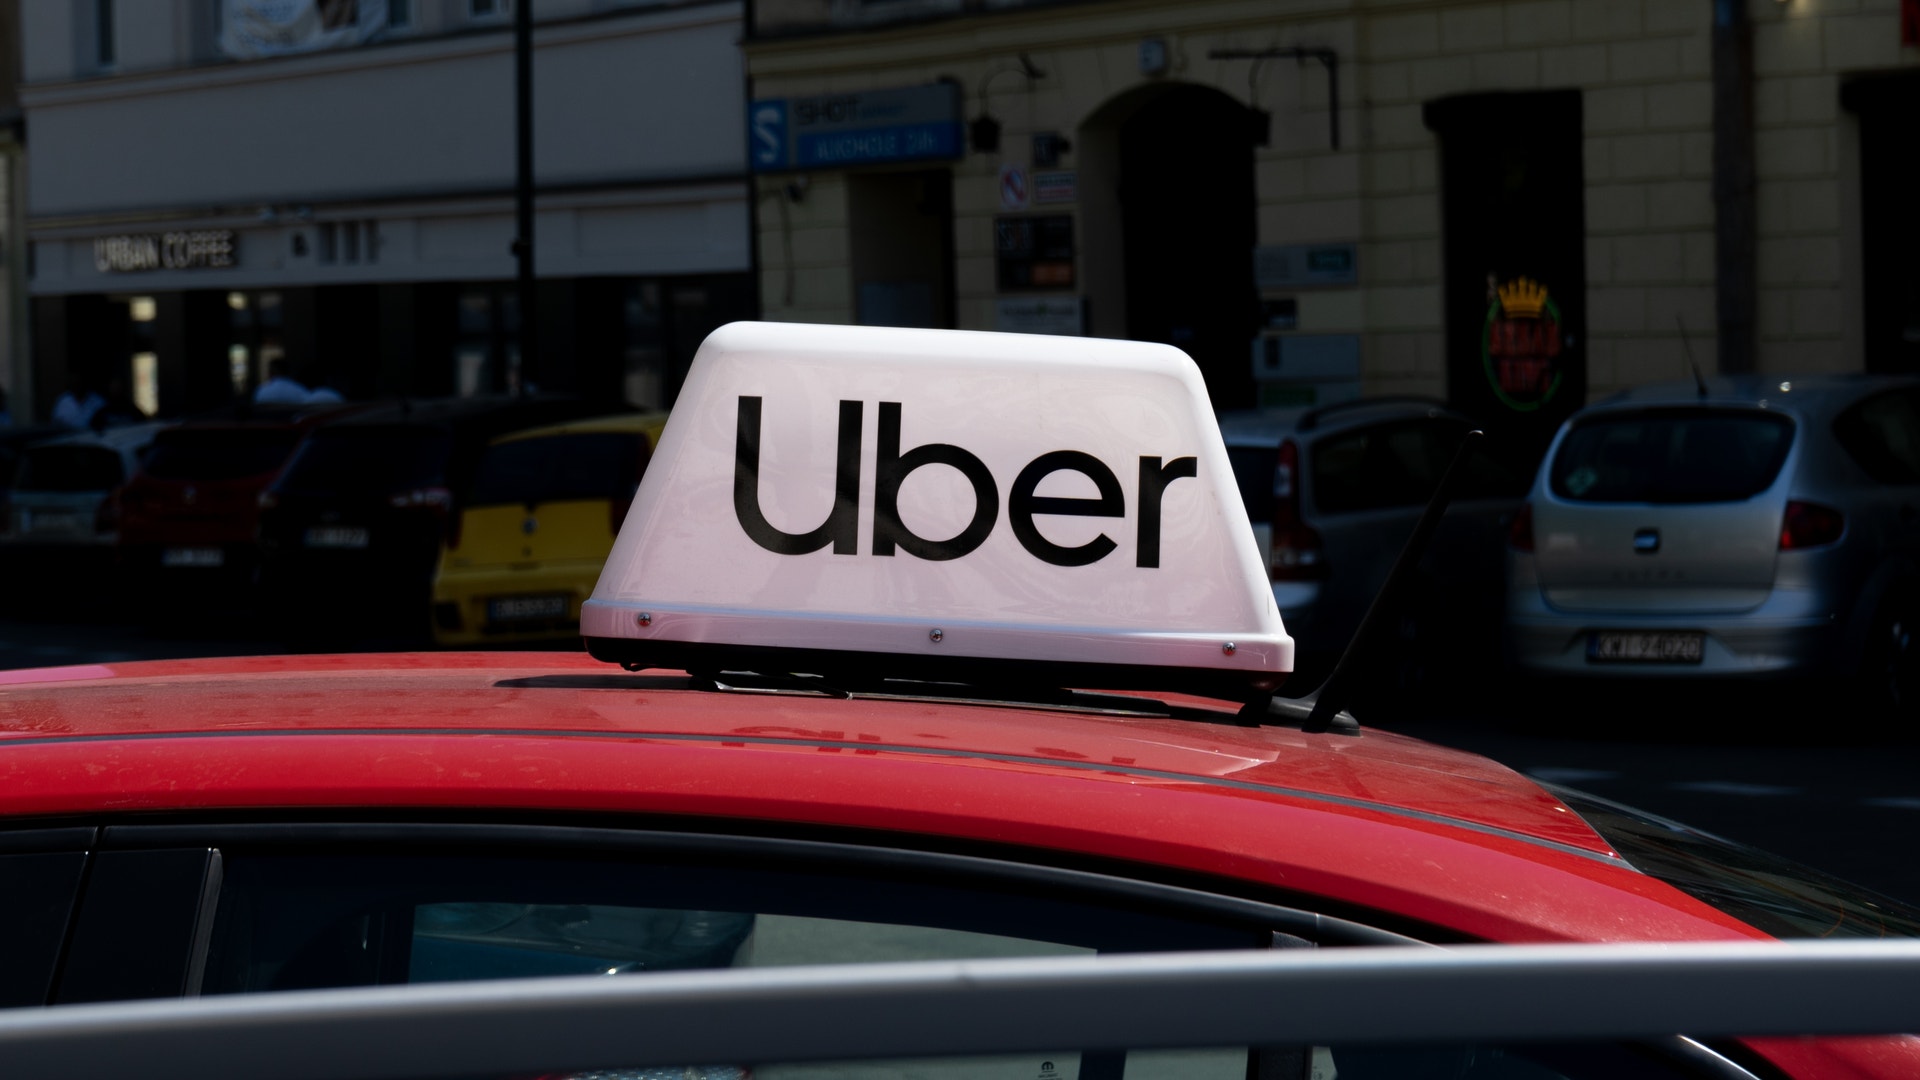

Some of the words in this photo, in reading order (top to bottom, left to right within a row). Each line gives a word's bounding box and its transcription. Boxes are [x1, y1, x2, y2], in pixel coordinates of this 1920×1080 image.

[795, 95, 859, 126] SHOT
[94, 234, 160, 273] URBAN
[162, 229, 234, 268] COFFEE
[734, 395, 1197, 568] Uber
